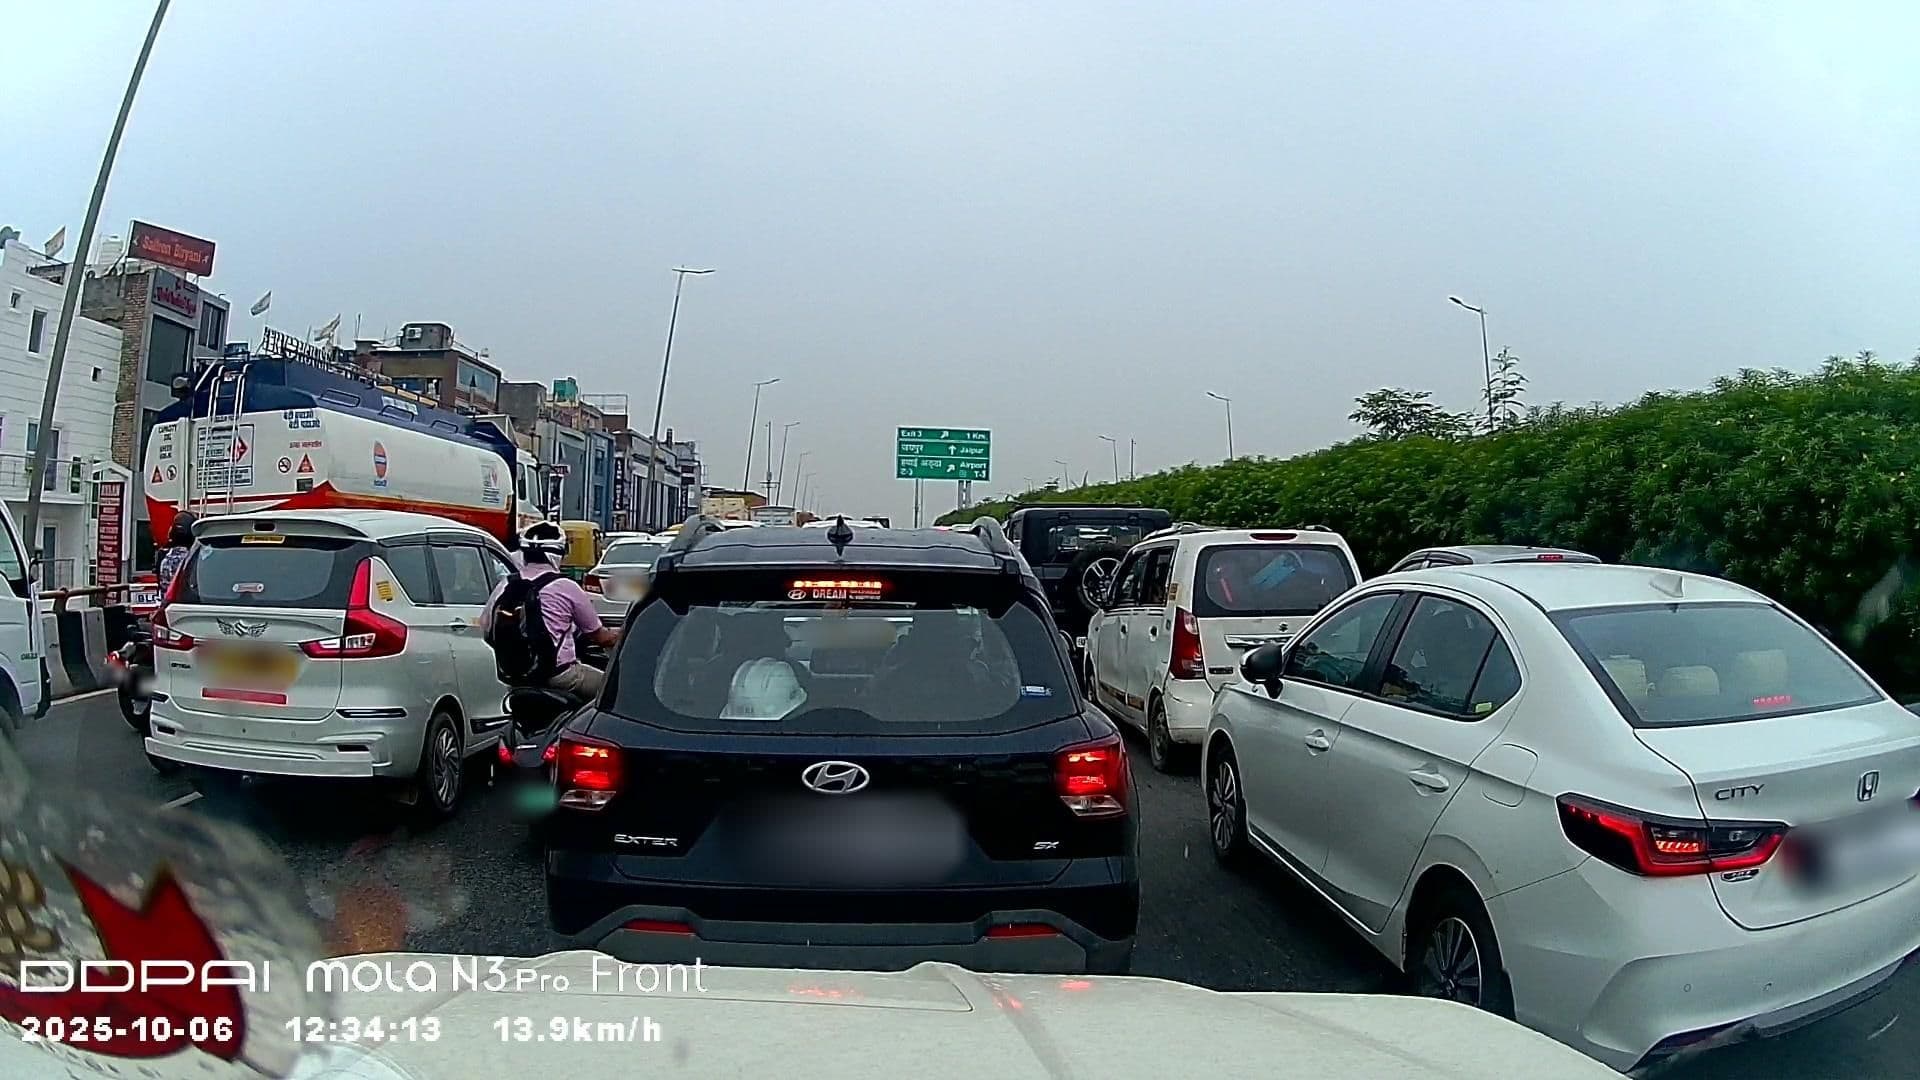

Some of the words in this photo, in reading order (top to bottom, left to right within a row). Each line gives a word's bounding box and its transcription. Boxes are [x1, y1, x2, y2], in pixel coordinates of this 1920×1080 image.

[960, 447, 984, 455] Jaipur
[960, 461, 987, 470] Airport
[974, 470, 986, 478] T-3
[812, 589, 847, 599] DREAM
[1715, 783, 1765, 801] CITY
[614, 833, 679, 847] EXTER
[1033, 841, 1060, 850] SX
